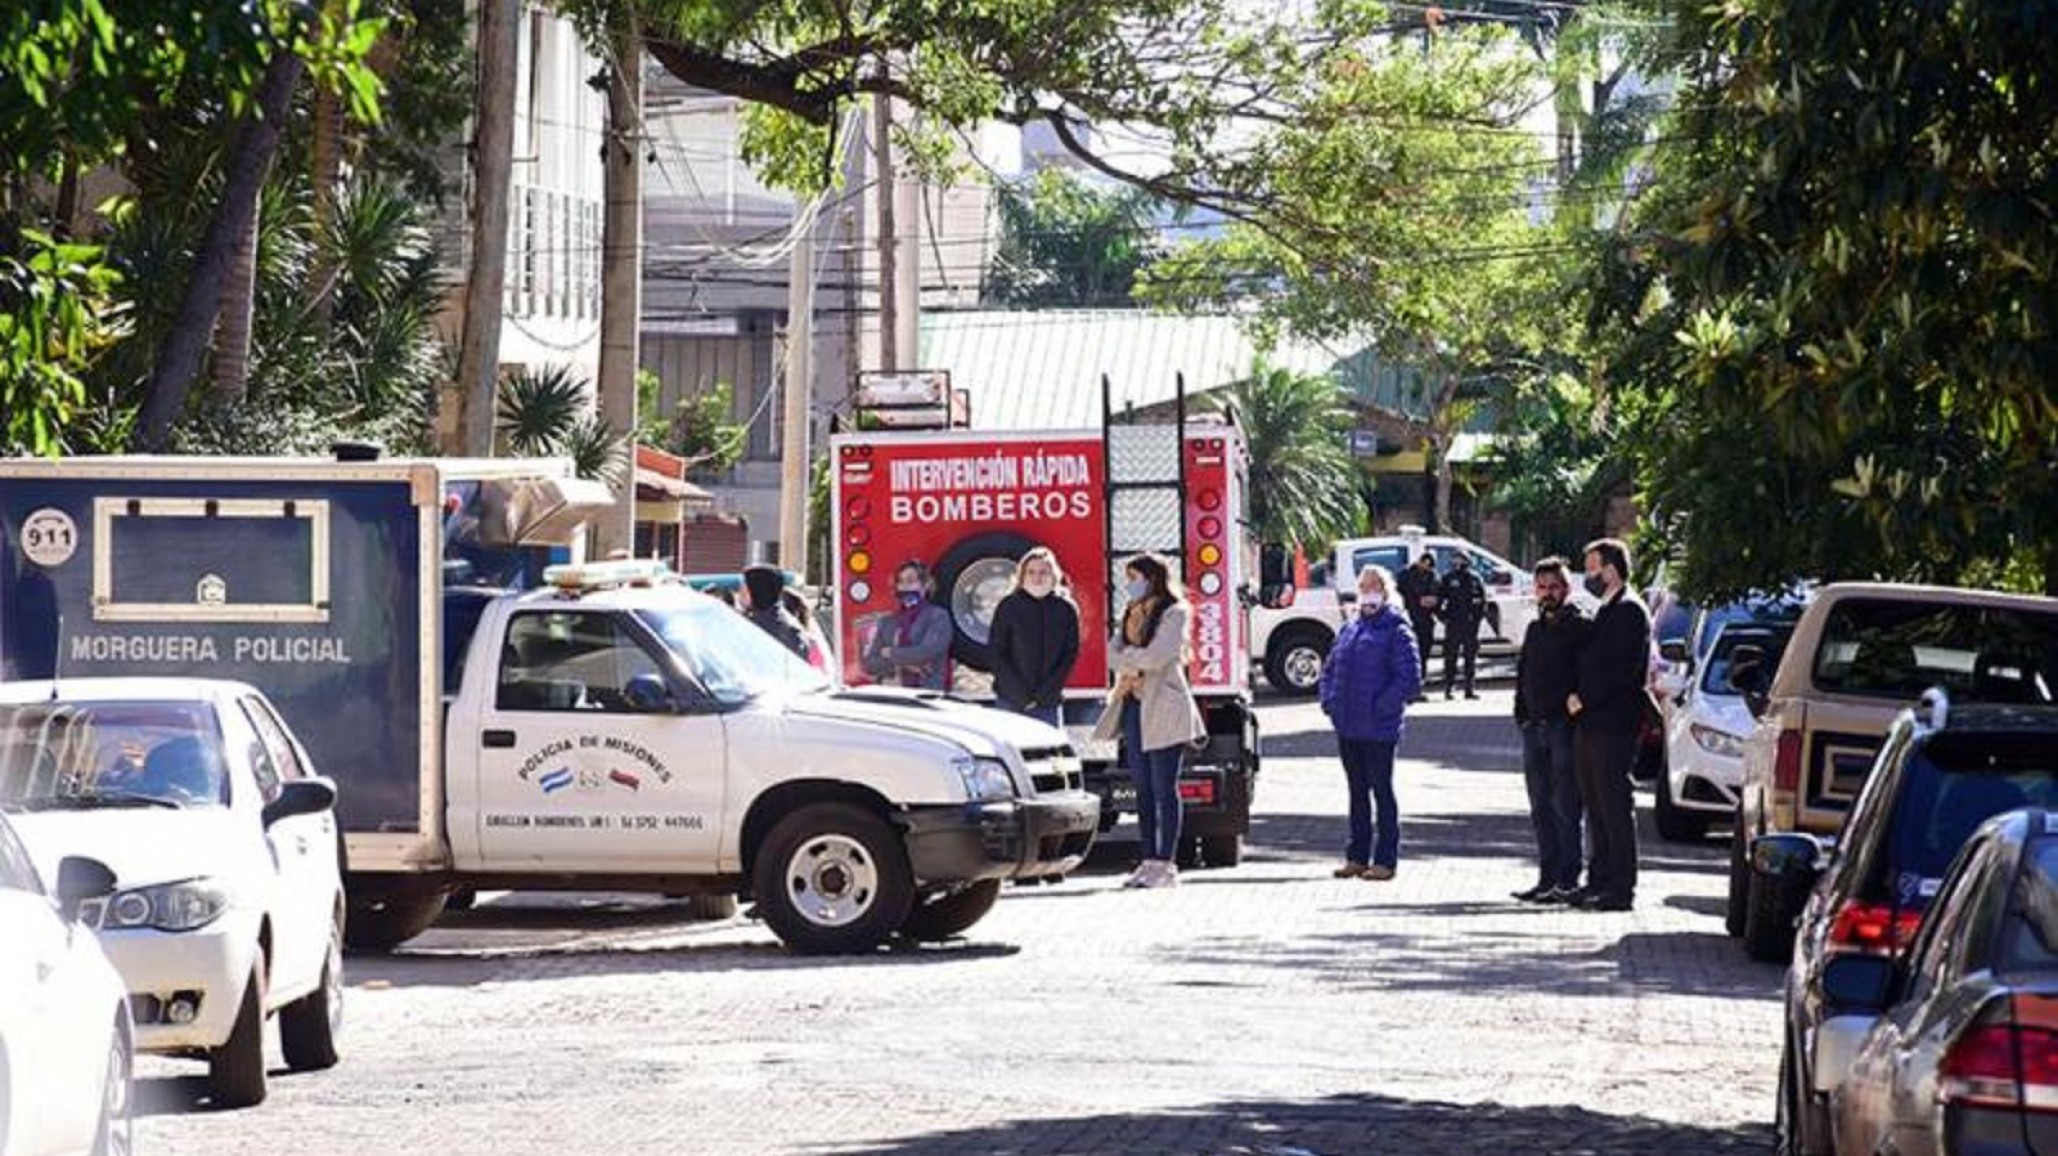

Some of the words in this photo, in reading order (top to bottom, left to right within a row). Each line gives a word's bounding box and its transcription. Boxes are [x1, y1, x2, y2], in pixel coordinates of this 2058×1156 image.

[889, 448, 1017, 492] INTERVENCIÓN
[1022, 447, 1090, 487] RÁPIDA
[890, 491, 1091, 523] BOMBEROS
[28, 528, 71, 547] 911
[70, 635, 218, 661] MORGUERA
[234, 636, 351, 663] POLICIAL
[518, 738, 574, 781] POLICIA
[579, 735, 599, 748] DE
[604, 736, 673, 784] MISIONES
